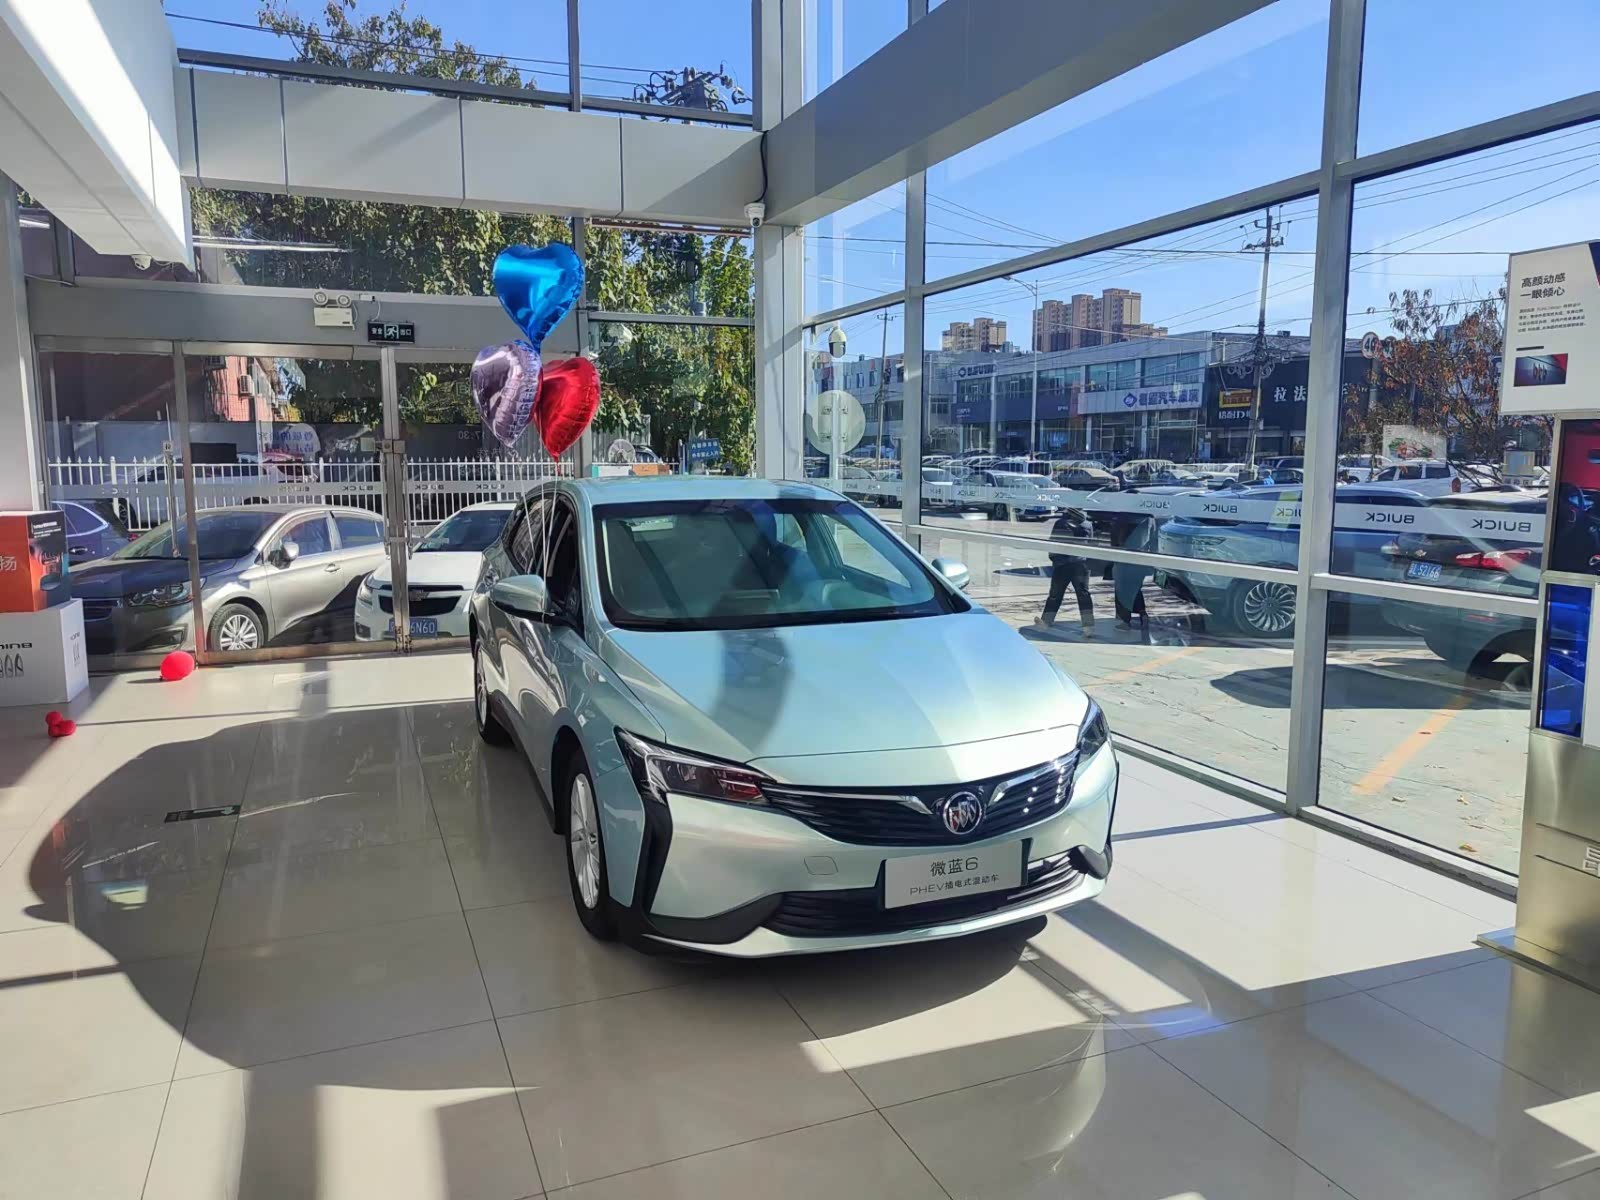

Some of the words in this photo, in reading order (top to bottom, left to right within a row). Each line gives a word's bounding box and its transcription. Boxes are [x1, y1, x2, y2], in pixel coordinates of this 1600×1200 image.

[1521, 272, 1566, 288] 高颜动感
[1520, 286, 1566, 299] 一眼倾心
[1274, 386, 1307, 402] 拉法
[930, 856, 979, 877] 微蓝6
[909, 874, 1000, 896] PHEV插电式混动车
